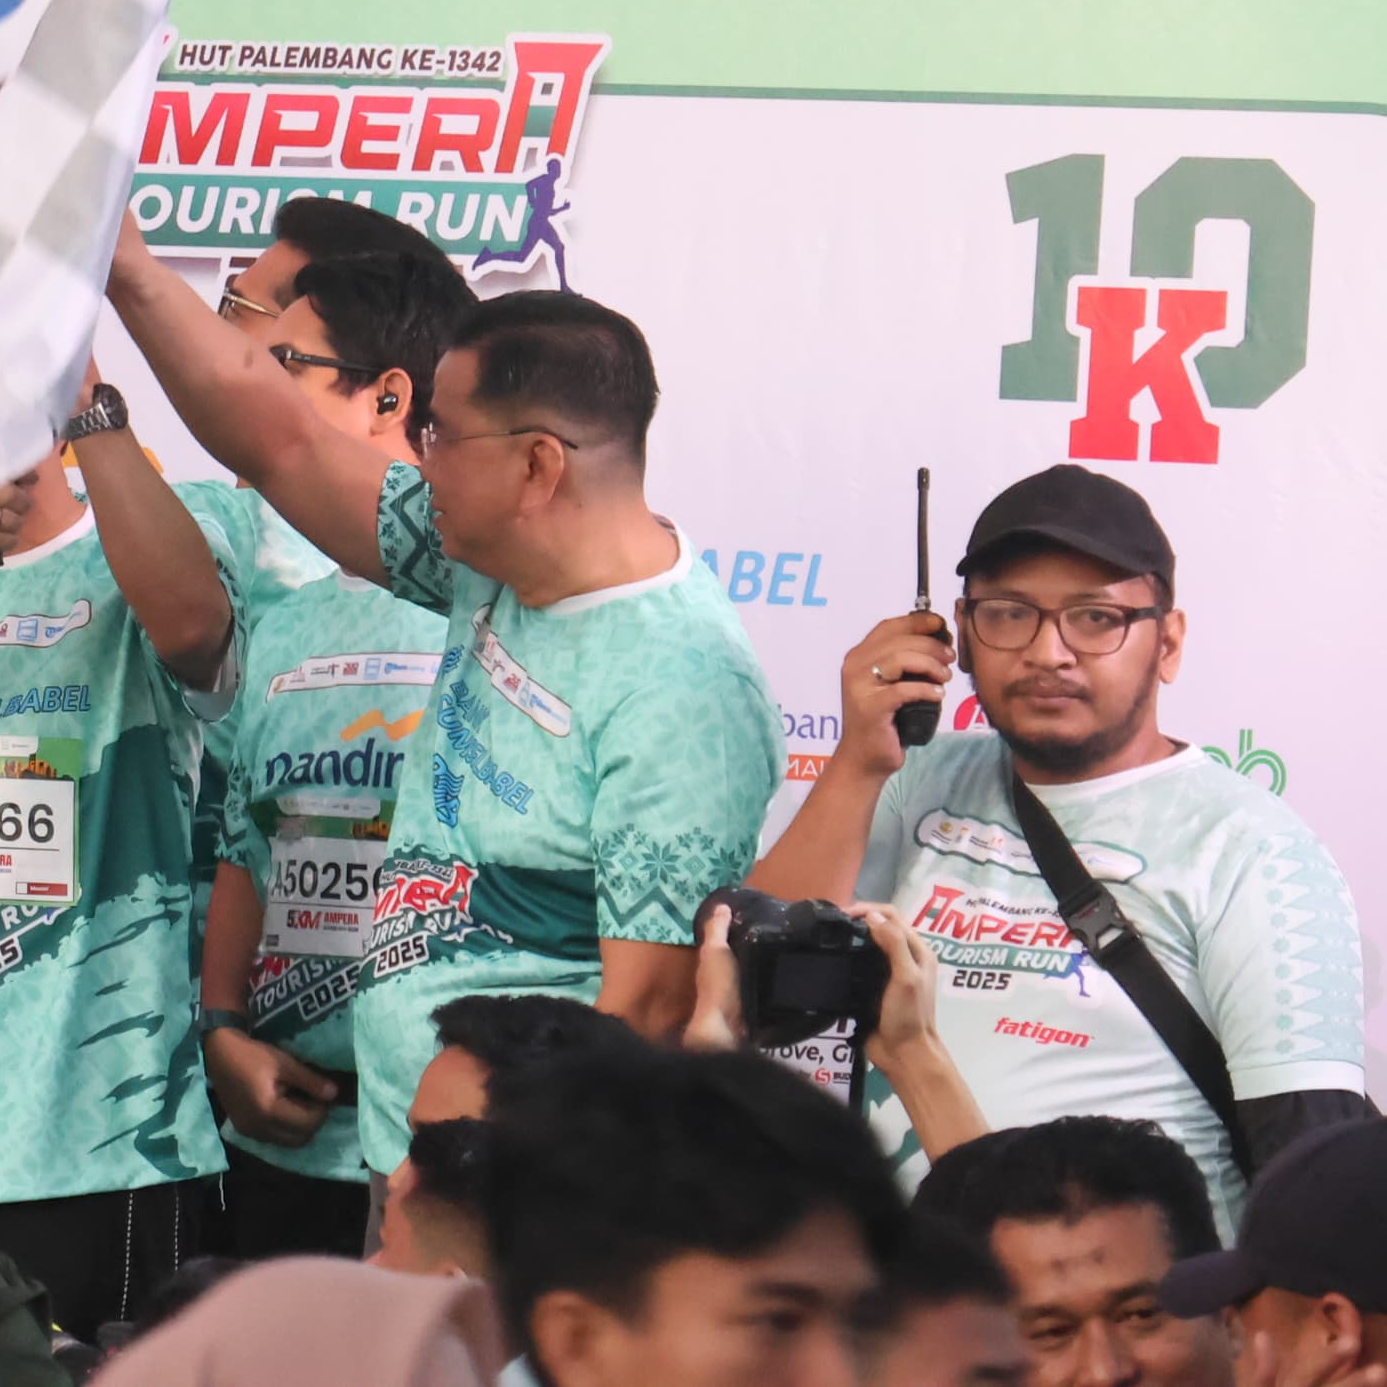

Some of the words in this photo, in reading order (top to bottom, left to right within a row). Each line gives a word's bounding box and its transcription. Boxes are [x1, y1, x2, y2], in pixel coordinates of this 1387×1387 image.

[178, 43, 234, 68] HUT
[238, 45, 393, 71] PALEMBANG
[399, 49, 502, 73] KE-1342
[139, 41, 604, 174] MPERA
[271, 859, 383, 902] A5025
[323, 912, 360, 928] AMPERA
[377, 934, 427, 974] 2025
[1012, 951, 1071, 973] RUN
[952, 969, 1012, 991] 2025
[993, 1016, 1090, 1049] fatigon
